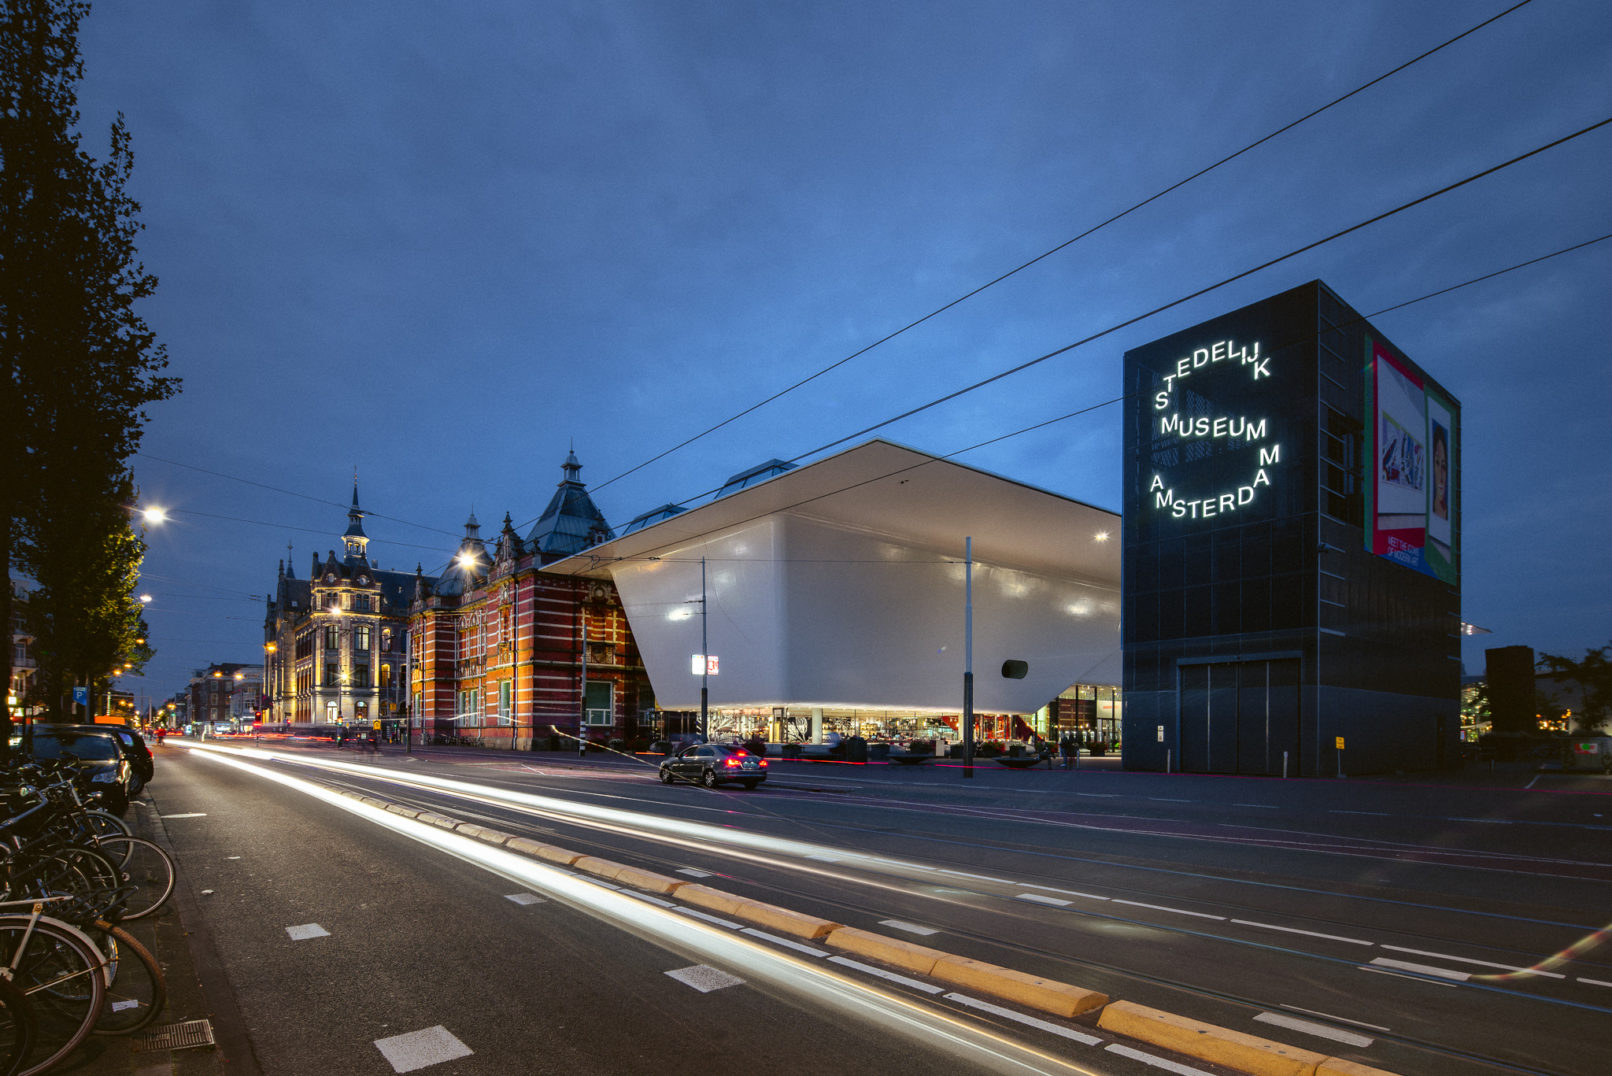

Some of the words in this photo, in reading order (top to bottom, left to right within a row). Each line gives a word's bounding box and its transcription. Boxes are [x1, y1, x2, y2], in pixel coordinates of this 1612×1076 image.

[1155, 340, 1271, 410] STEDELIJK
[1161, 413, 1267, 442] MUSEUM
[1150, 444, 1280, 519] AMSTERDAM
